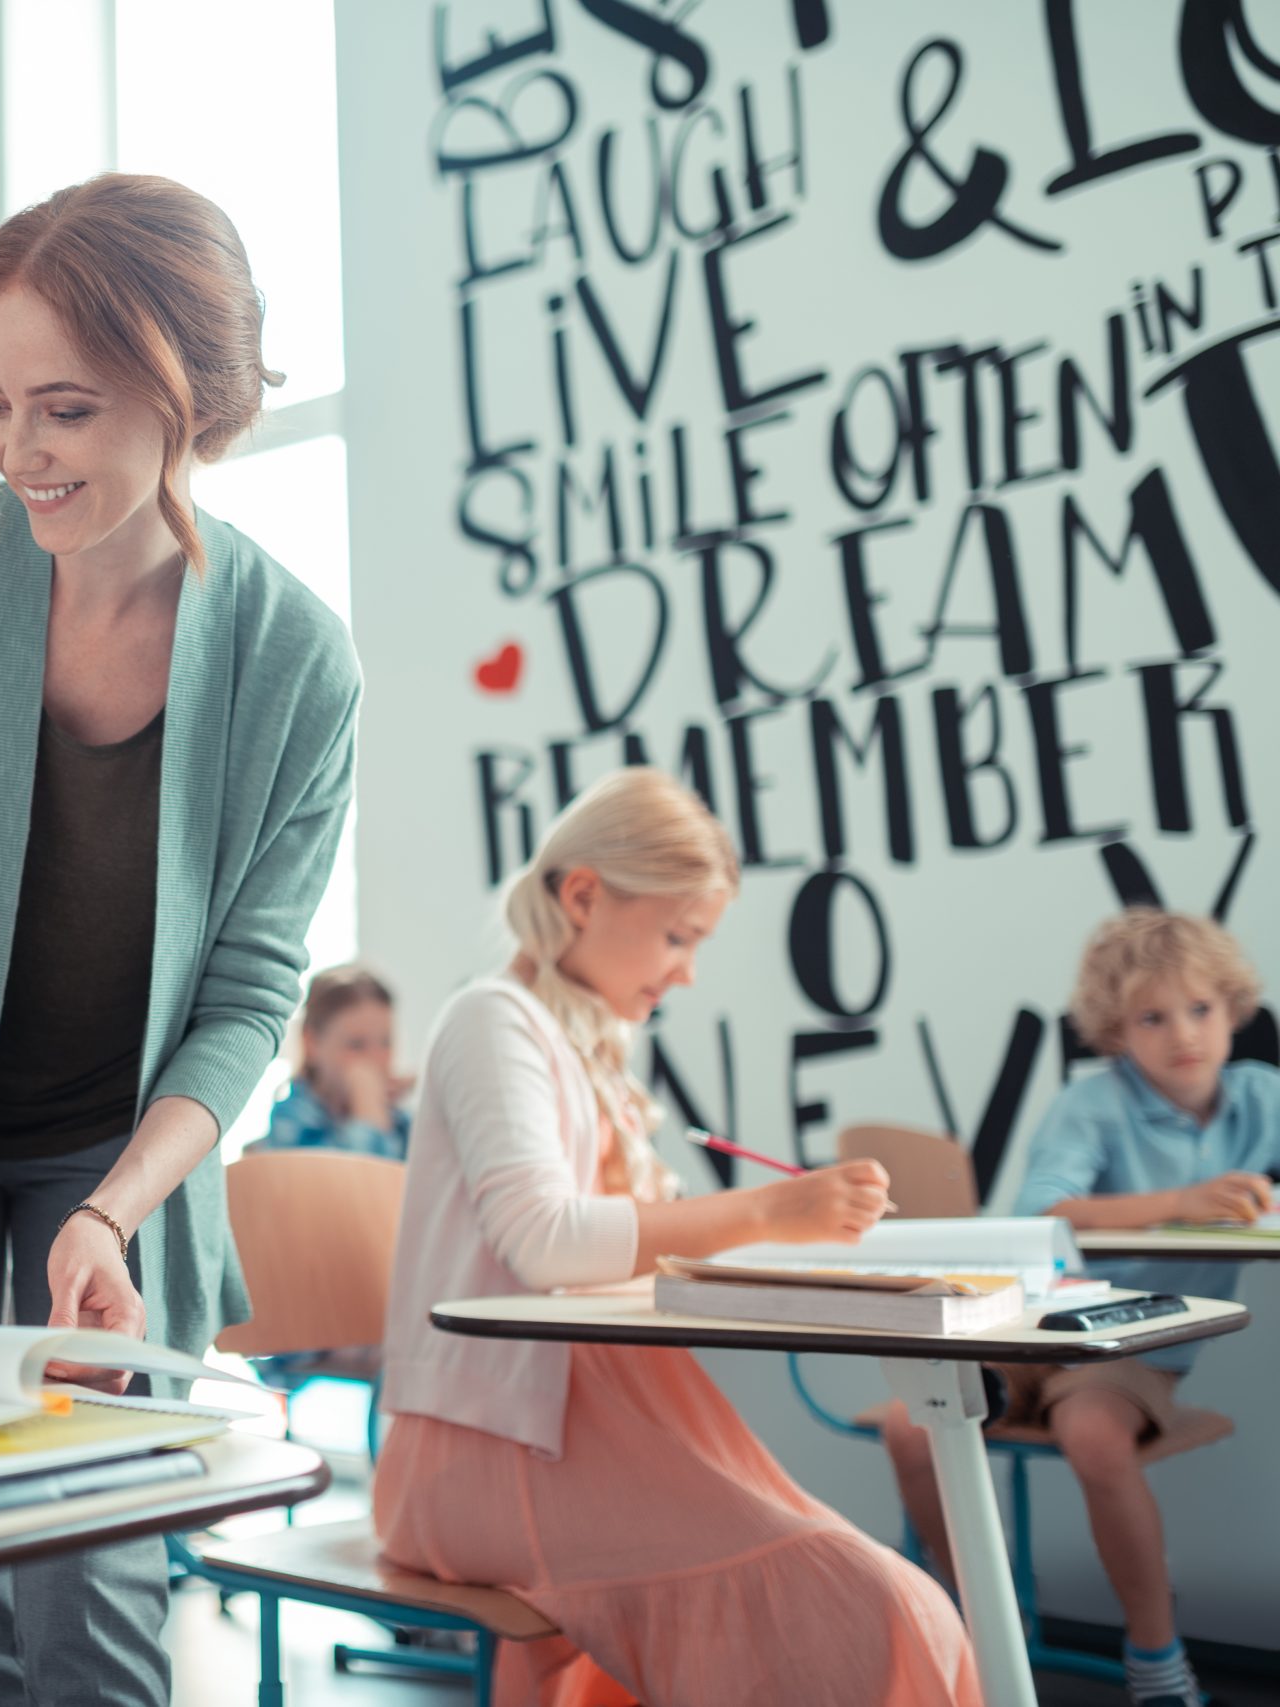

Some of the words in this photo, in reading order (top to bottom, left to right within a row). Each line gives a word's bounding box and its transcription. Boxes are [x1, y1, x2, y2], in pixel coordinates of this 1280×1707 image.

[456, 62, 810, 288] LAUGH
[459, 208, 827, 470] LiVE
[828, 310, 1133, 512] OFTEN
[1130, 262, 1204, 356] iN
[456, 408, 793, 600] SMiLE
[542, 466, 1218, 736] DREAM
